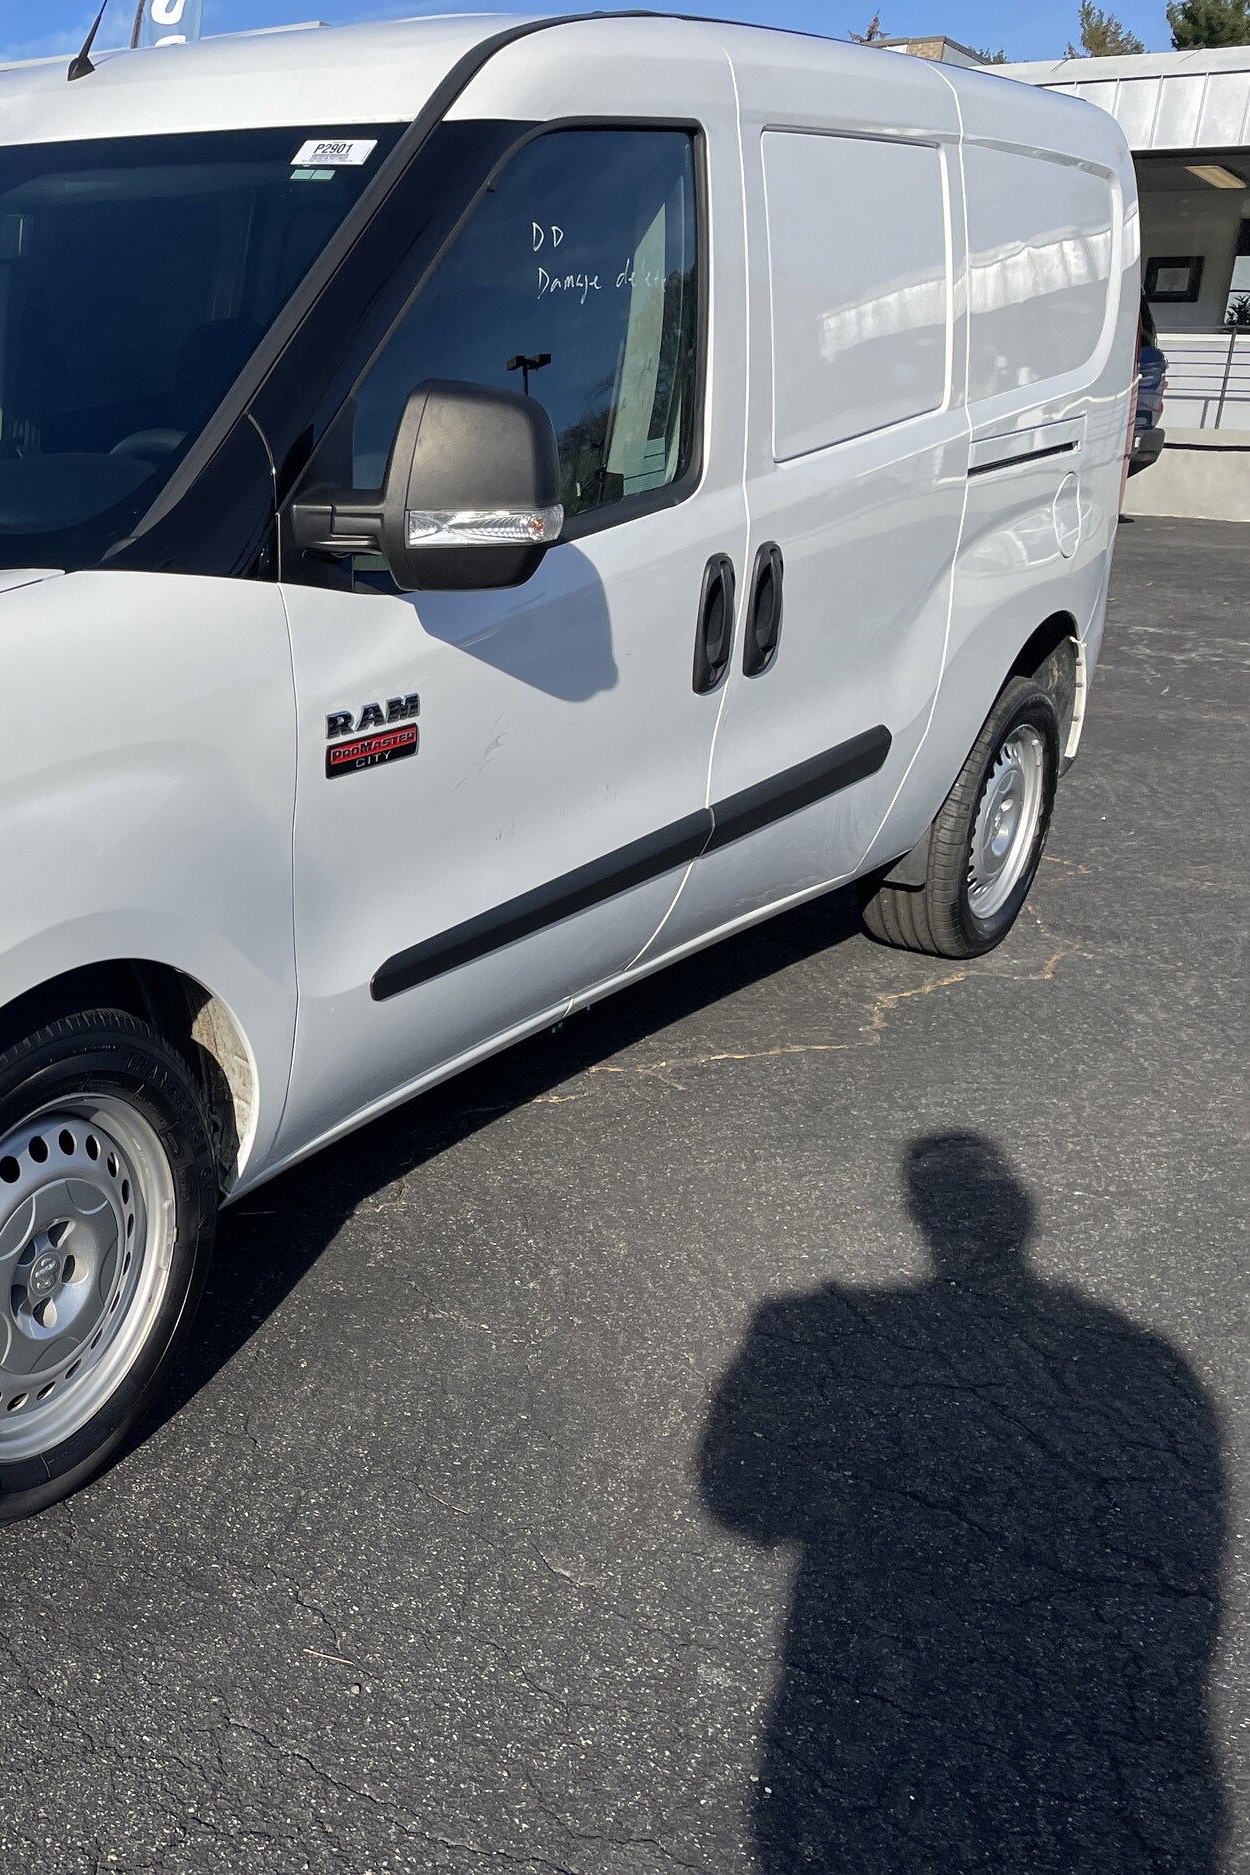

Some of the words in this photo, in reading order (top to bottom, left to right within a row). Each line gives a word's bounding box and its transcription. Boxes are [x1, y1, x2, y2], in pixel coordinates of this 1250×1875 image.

[314, 143, 353, 154] P2901
[537, 267, 603, 304] Damage
[325, 692, 420, 739] RAM
[356, 750, 391, 768] CITY
